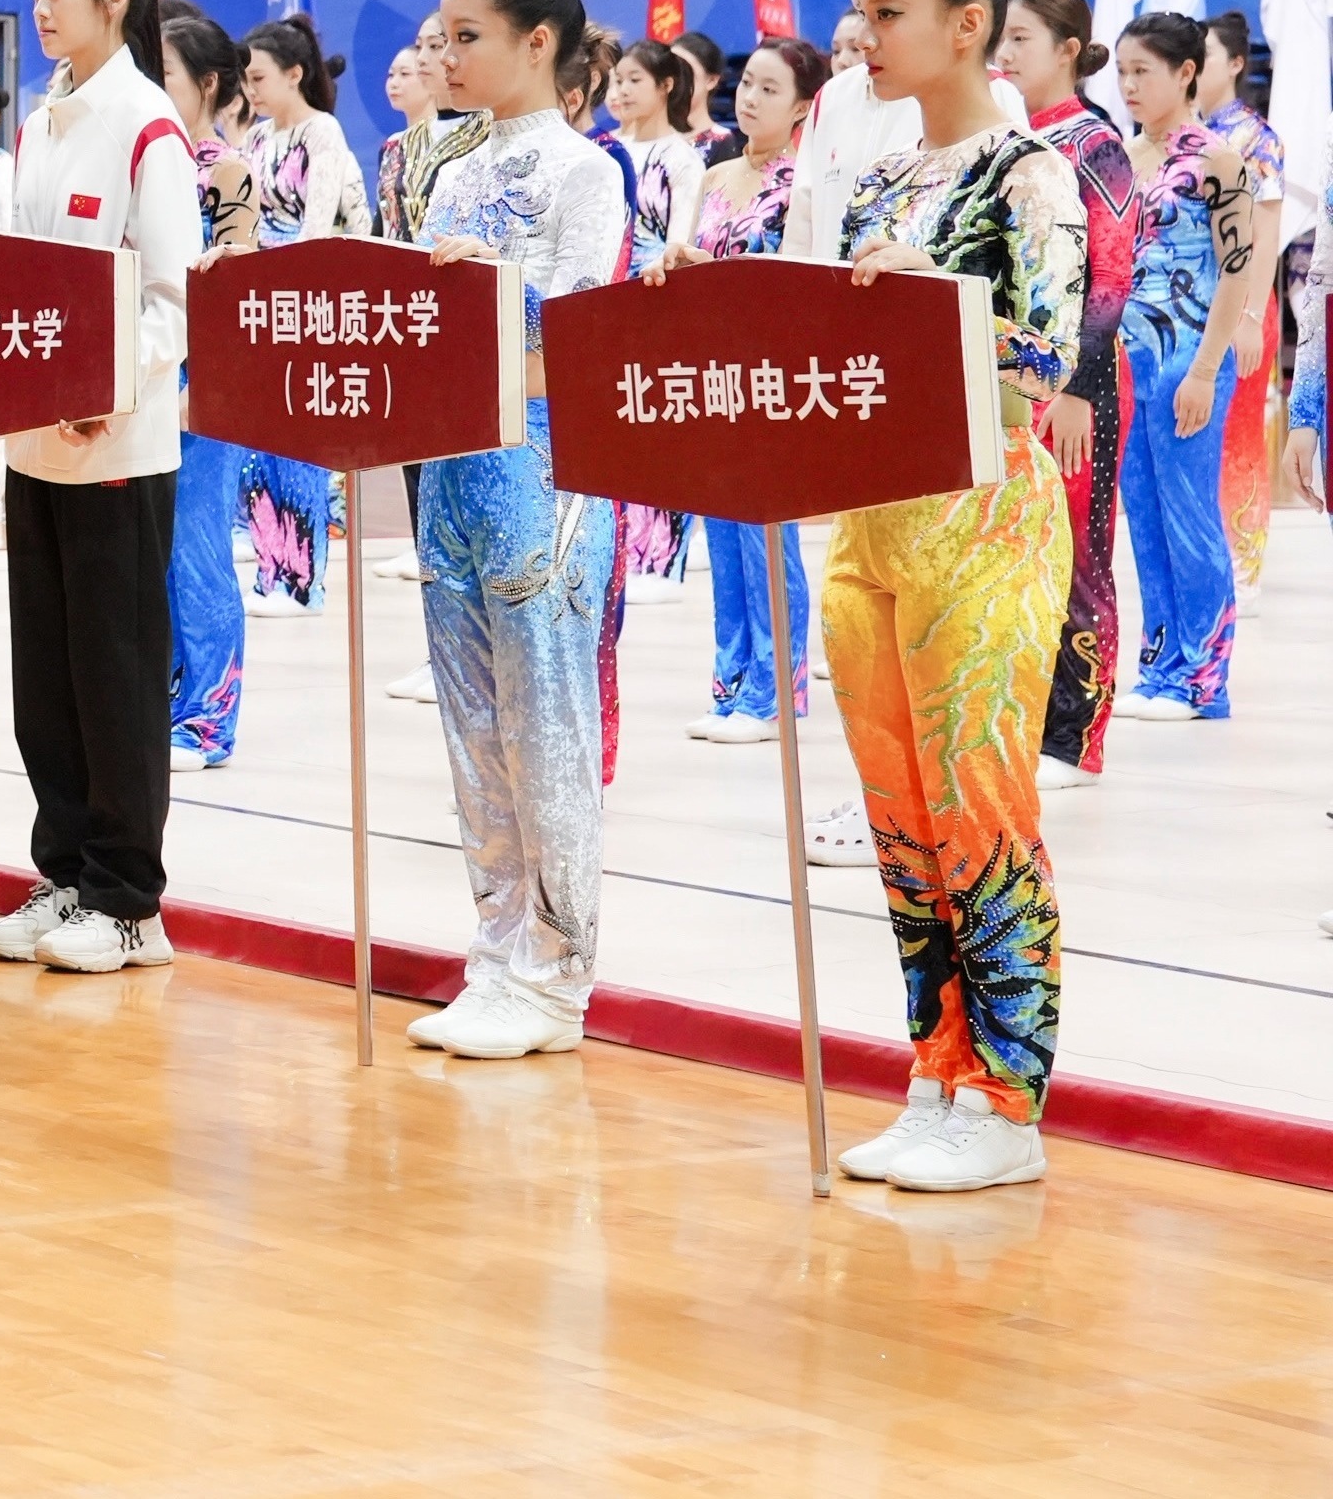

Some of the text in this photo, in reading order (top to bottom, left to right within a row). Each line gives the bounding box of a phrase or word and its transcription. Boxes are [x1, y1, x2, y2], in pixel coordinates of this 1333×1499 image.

[238, 289, 440, 348] 中国地质大学
[616, 353, 888, 425] 北京邮电大学
